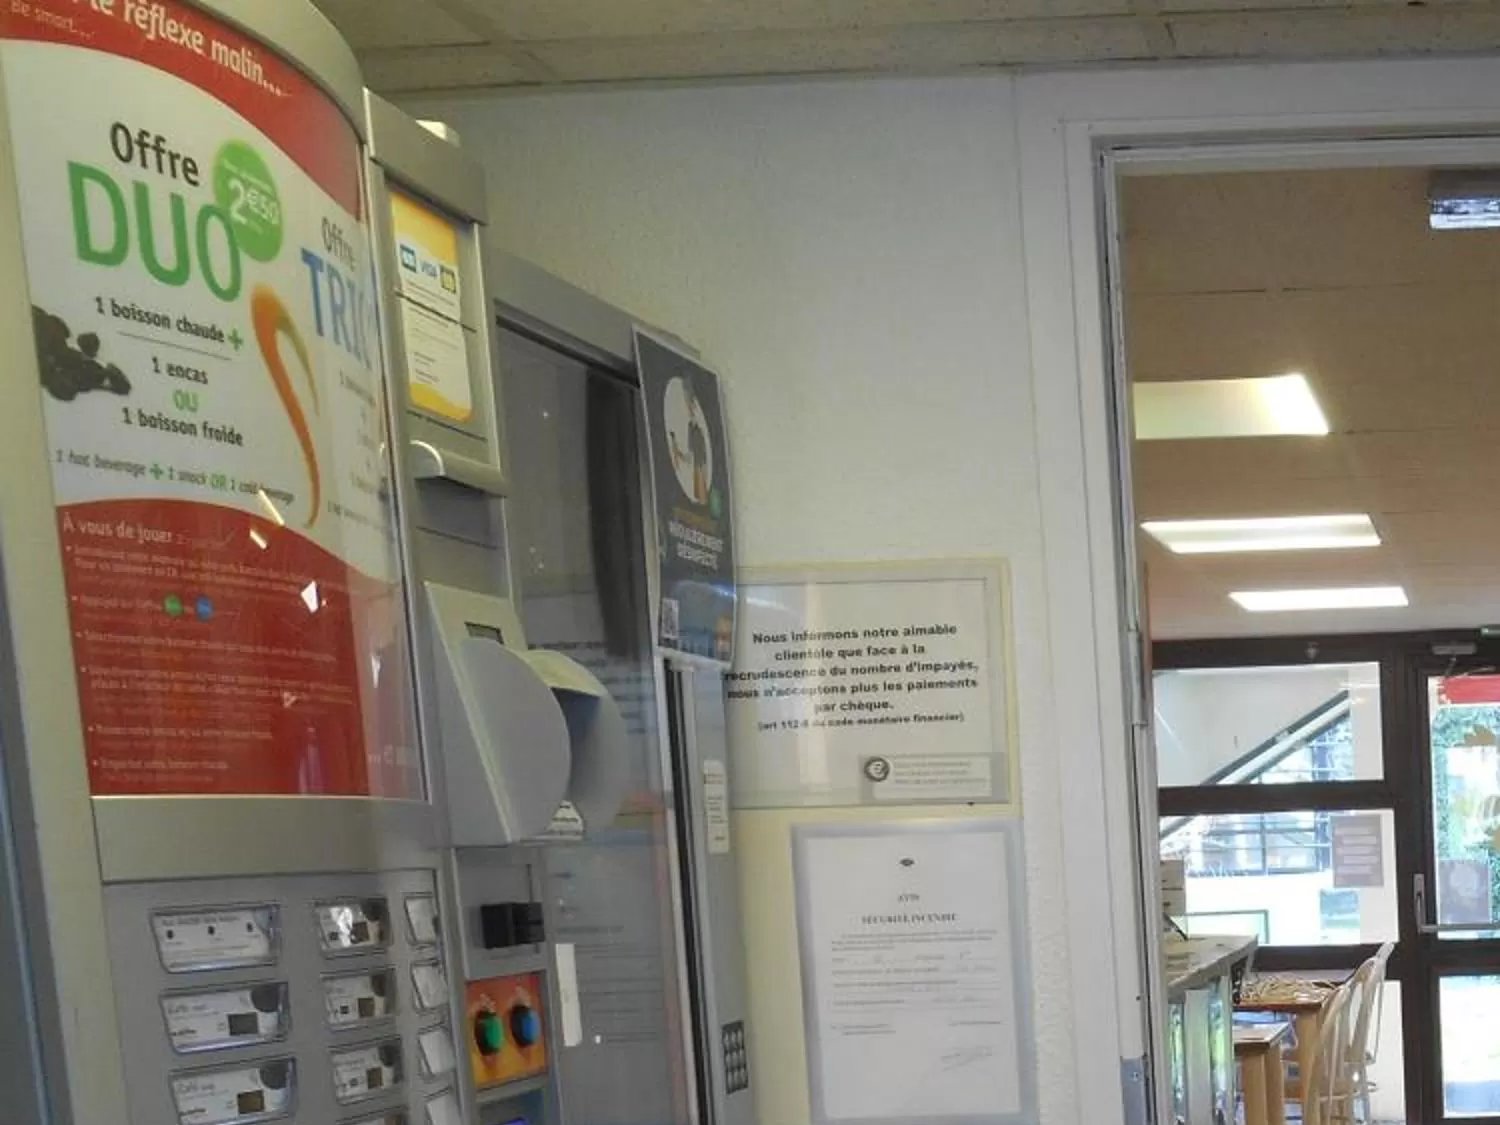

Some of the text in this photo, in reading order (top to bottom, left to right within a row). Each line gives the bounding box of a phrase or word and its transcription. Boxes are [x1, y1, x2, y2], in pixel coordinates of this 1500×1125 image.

[110, 121, 200, 187] Offre
[67, 160, 242, 302] DUO
[95, 296, 104, 315] 1
[112, 300, 171, 329] boisson
[176, 317, 225, 343] chaude
[152, 356, 208, 385] 1 encas
[173, 389, 199, 412] OU
[122, 407, 244, 447] 1 boisson froide
[78, 520, 113, 537] vous
[115, 520, 136, 539] de
[752, 624, 957, 643] Nous informons notre aimable
[837, 648, 863, 660] que
[867, 645, 897, 656] face
[912, 643, 925, 654] la
[830, 666, 847, 677] du
[851, 663, 901, 675] nombre
[850, 682, 878, 694] plus
[883, 681, 902, 692] les
[907, 678, 978, 692] paiements
